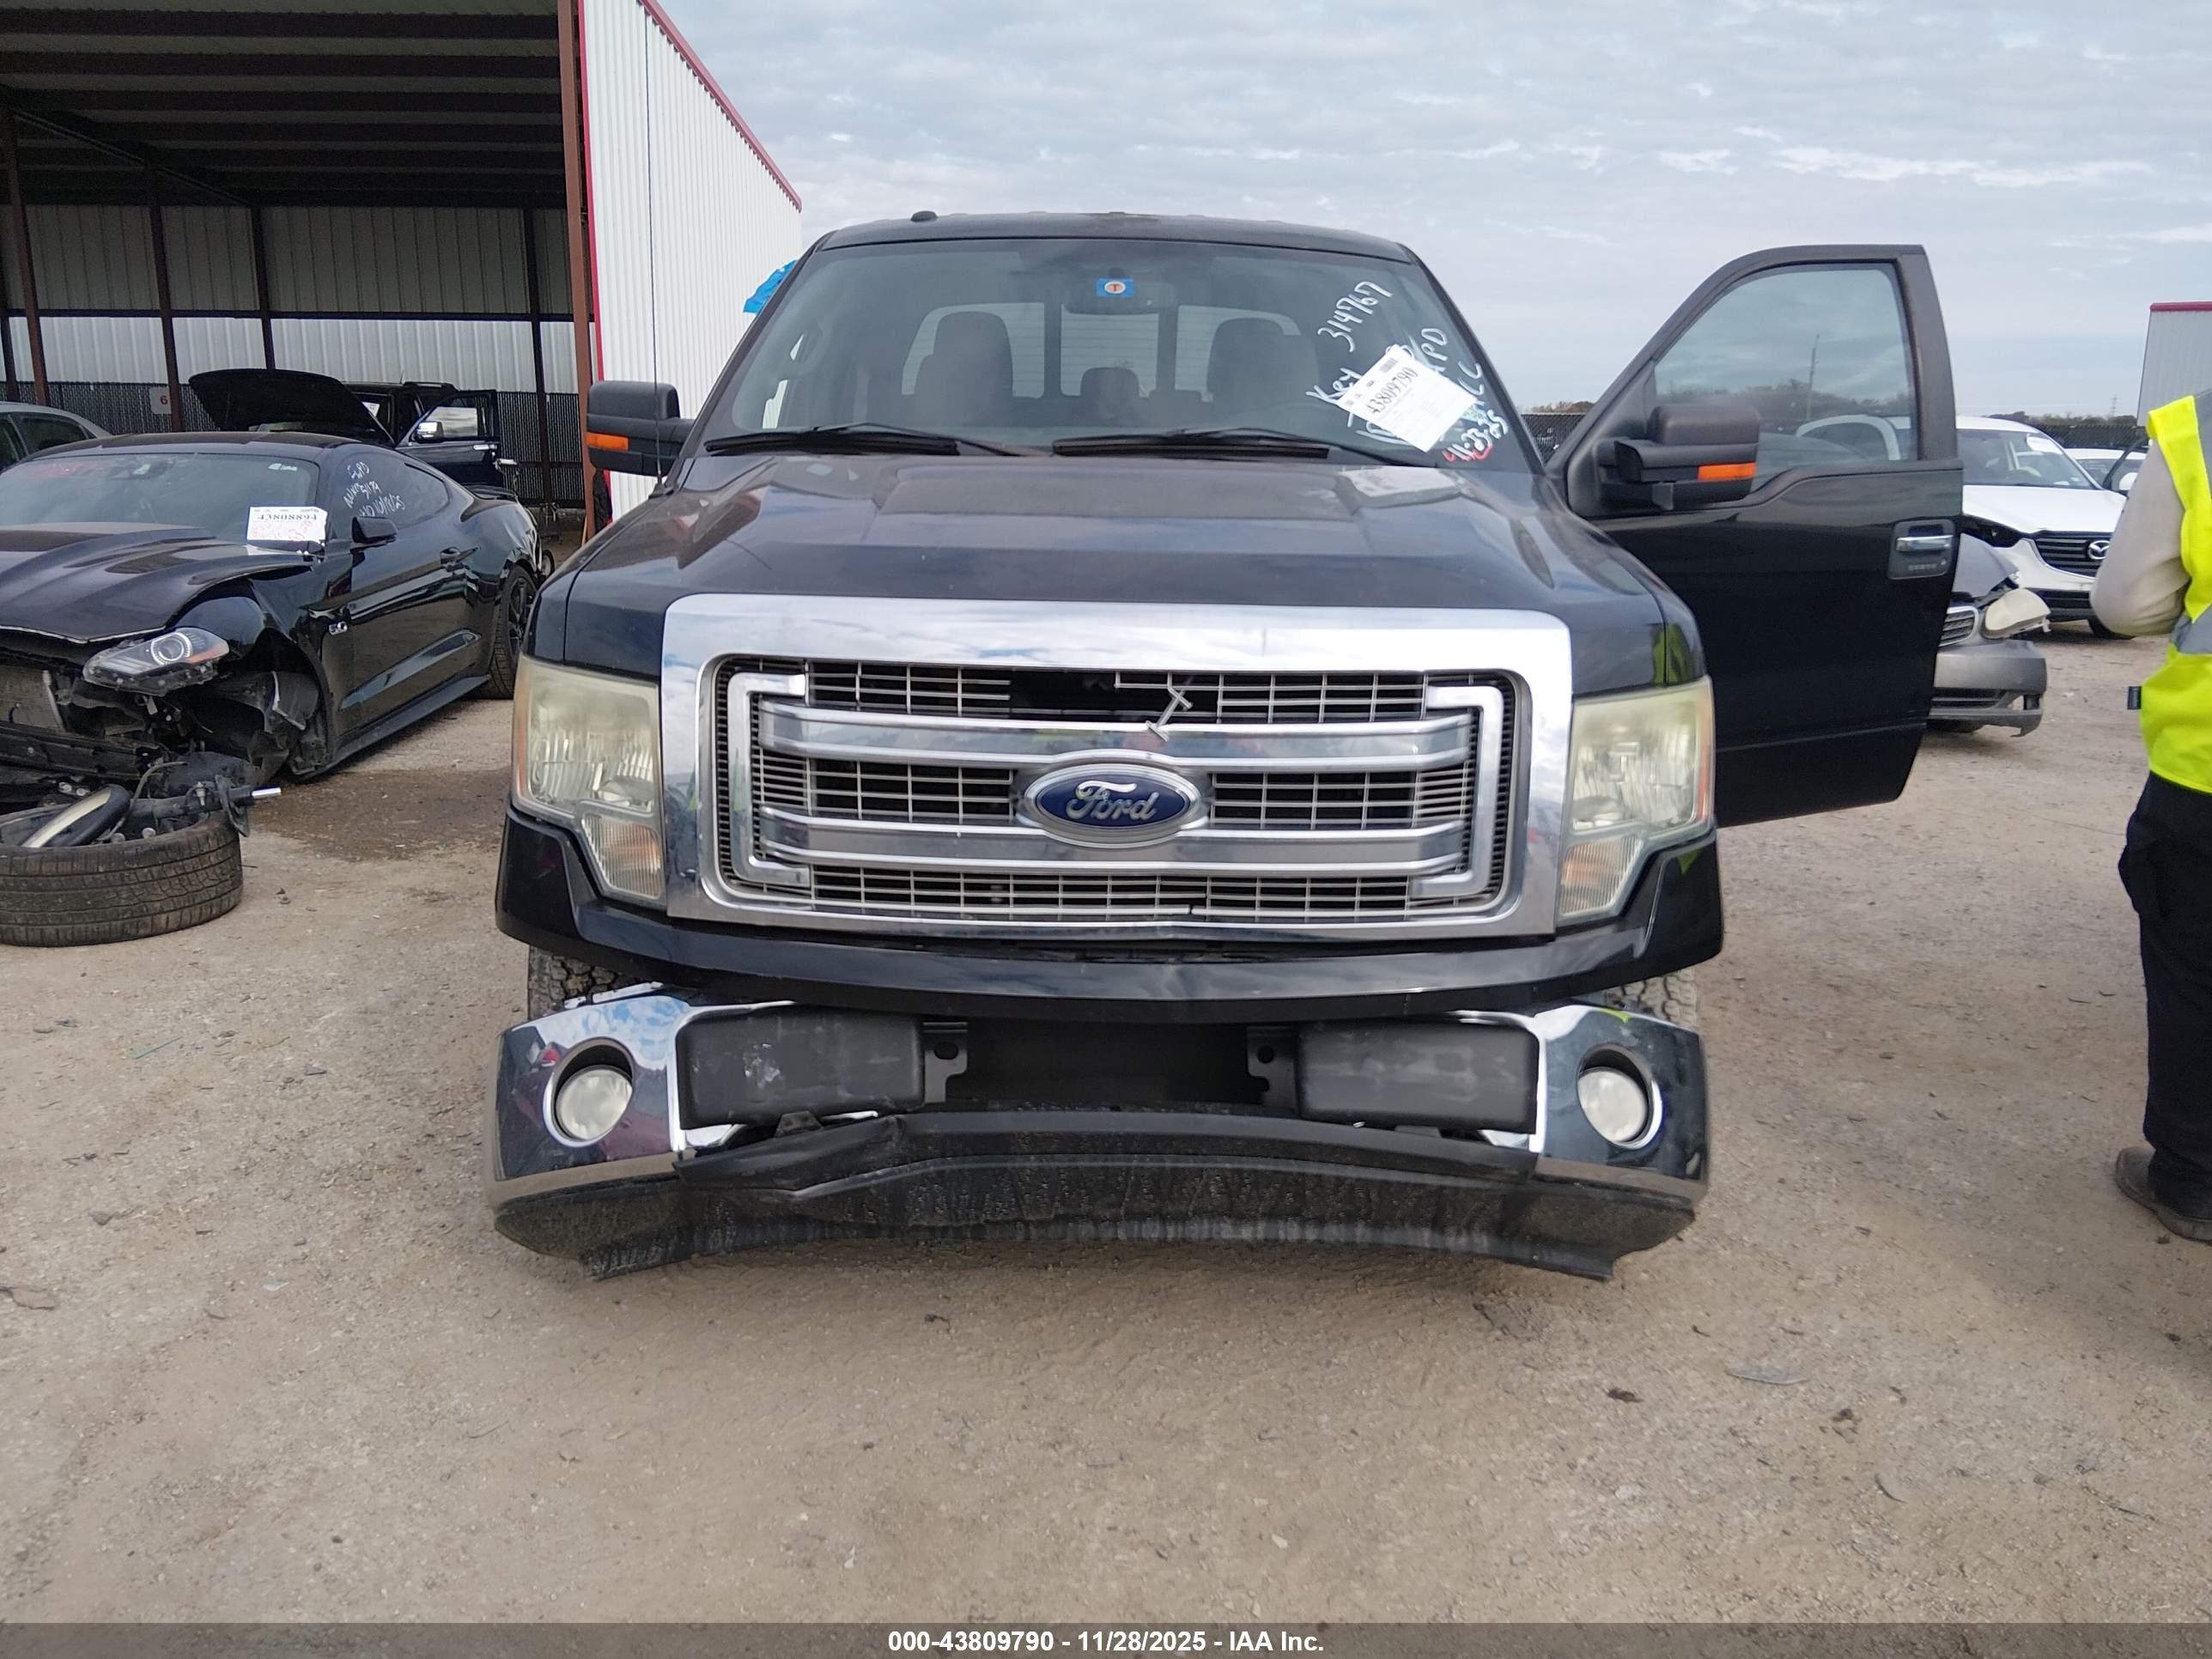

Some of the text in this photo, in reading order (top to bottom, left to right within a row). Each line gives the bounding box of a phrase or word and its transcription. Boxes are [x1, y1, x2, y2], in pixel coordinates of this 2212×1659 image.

[1317, 280, 1393, 353] 314767
[1364, 367, 1419, 415] 43809790
[1065, 780, 1159, 821] Ford
